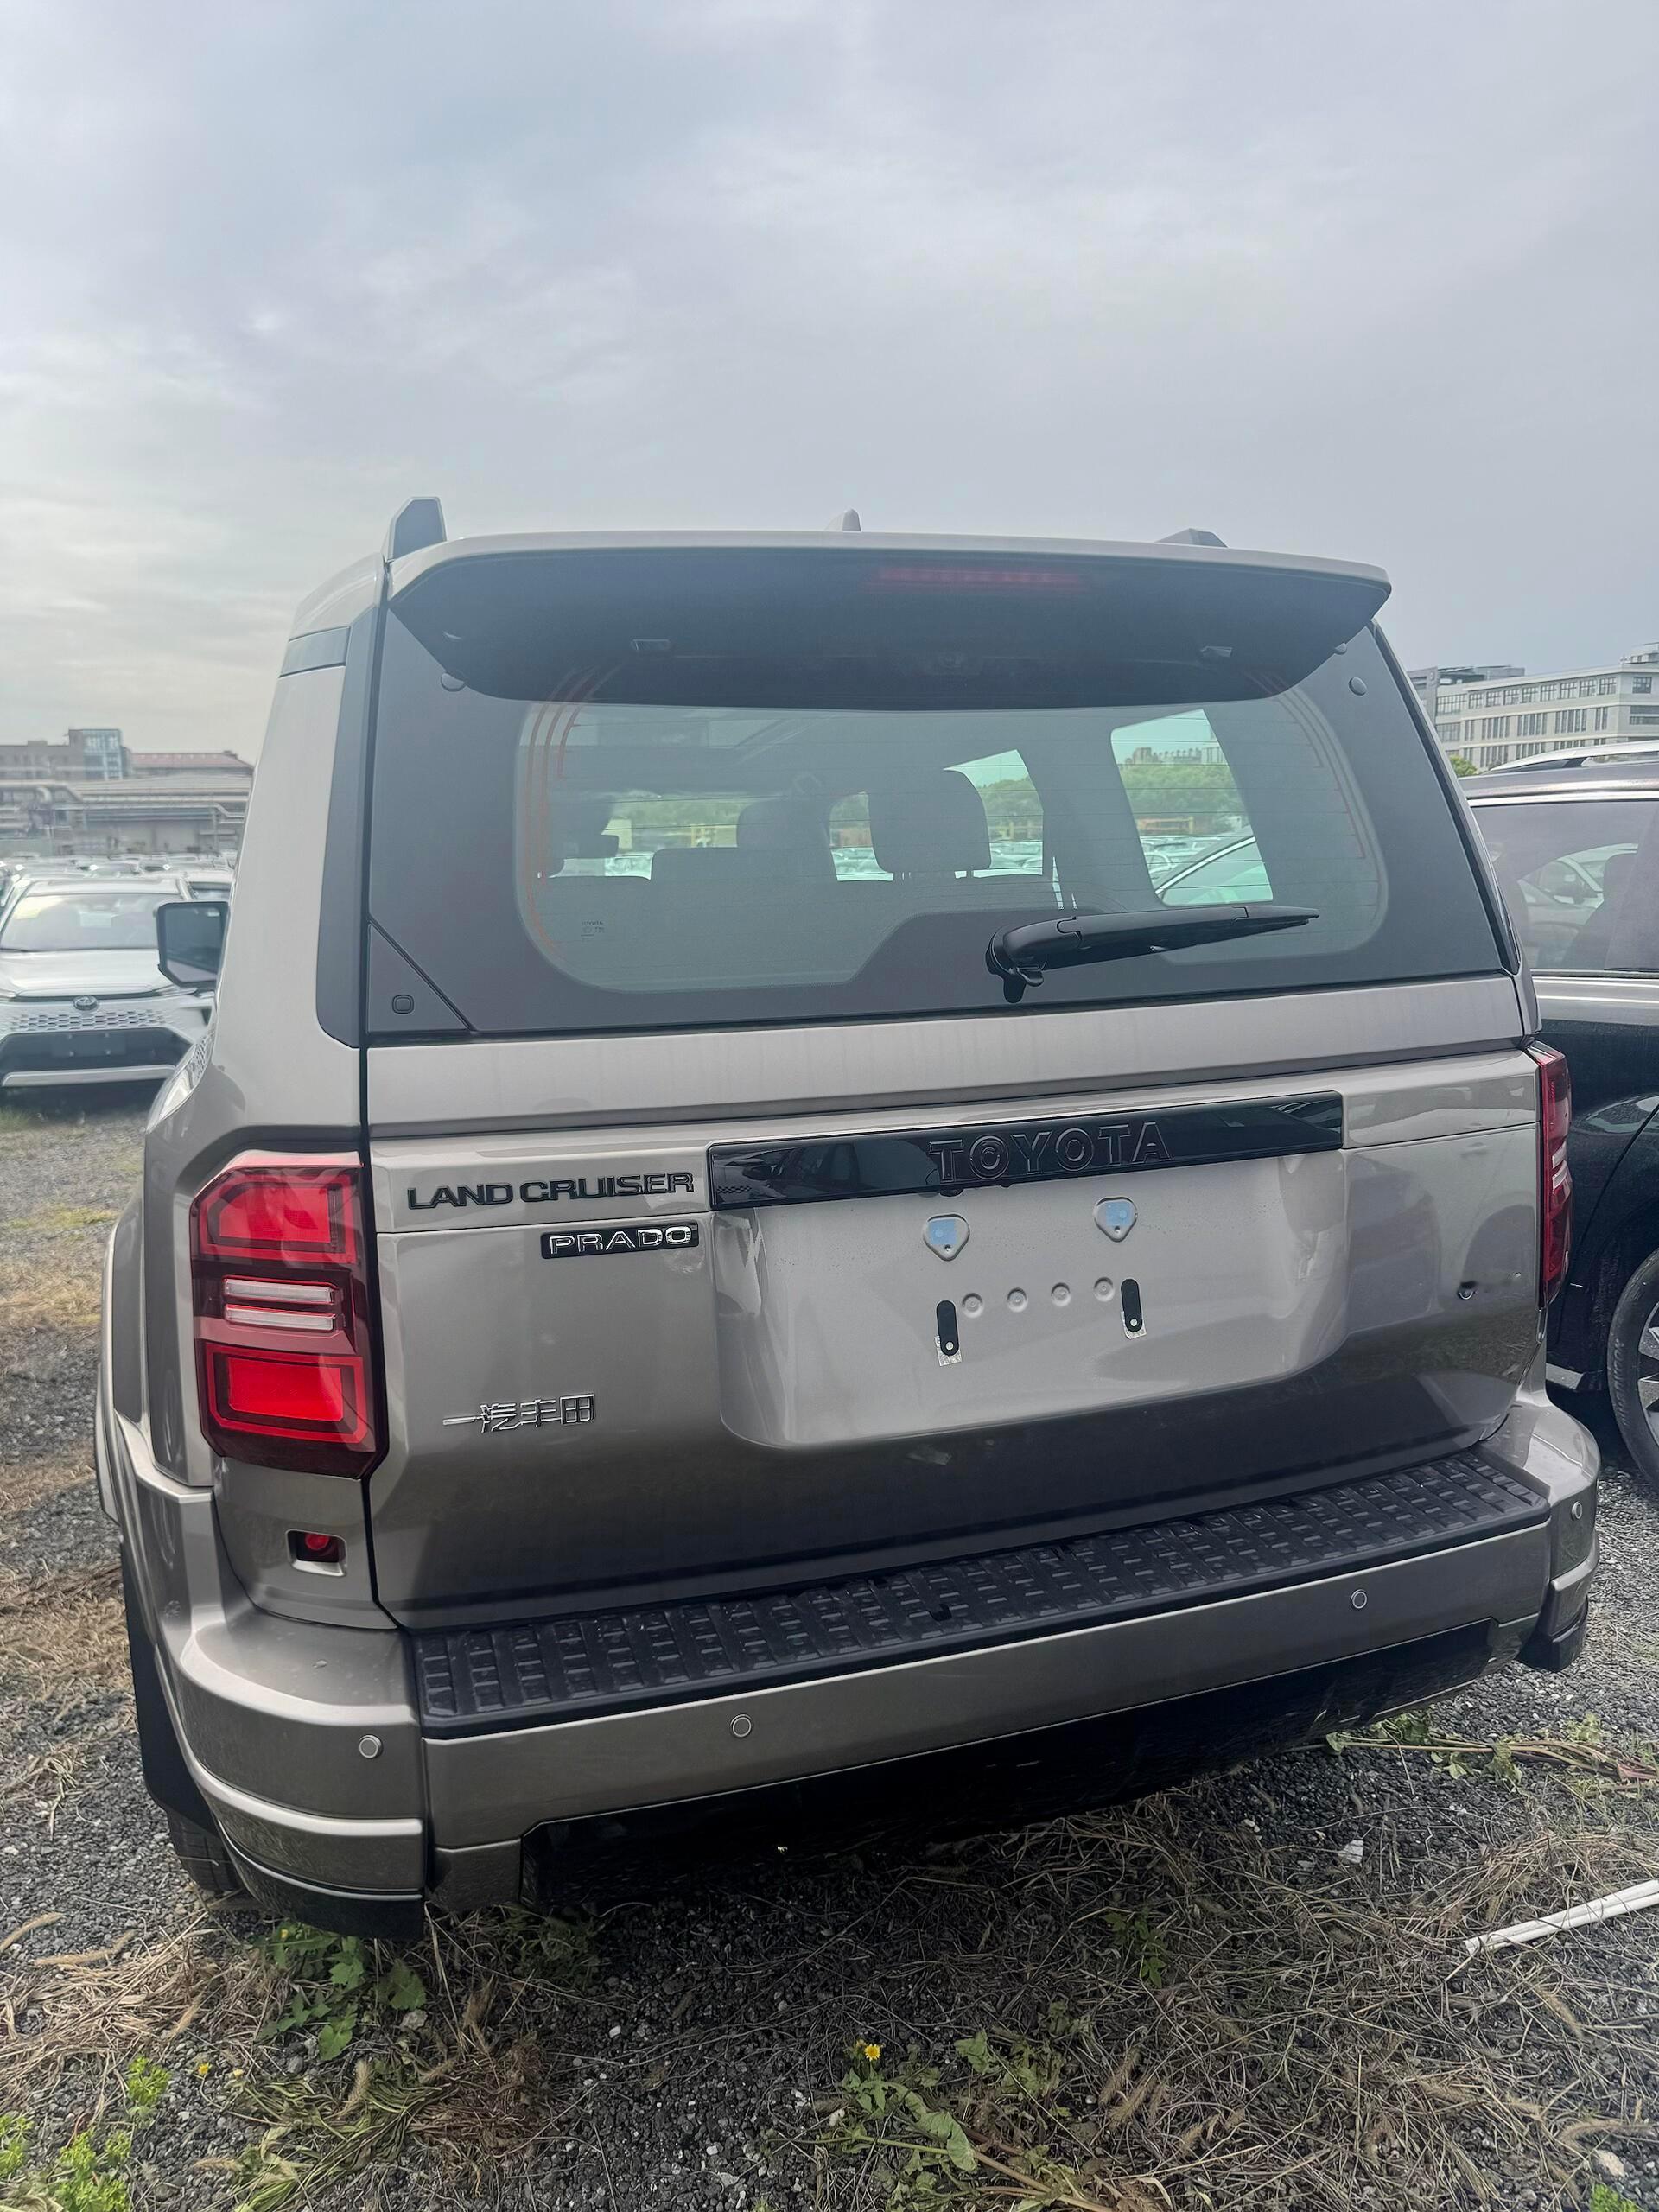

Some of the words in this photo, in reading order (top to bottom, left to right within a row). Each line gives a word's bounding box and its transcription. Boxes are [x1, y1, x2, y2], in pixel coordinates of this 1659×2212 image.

[928, 1121, 1172, 1185] TOYOTA
[407, 1183, 514, 1210] LAND
[520, 1172, 695, 1204] CRUISER
[549, 1225, 693, 1255] PRADO
[442, 1393, 595, 1434] 一汽丰田
